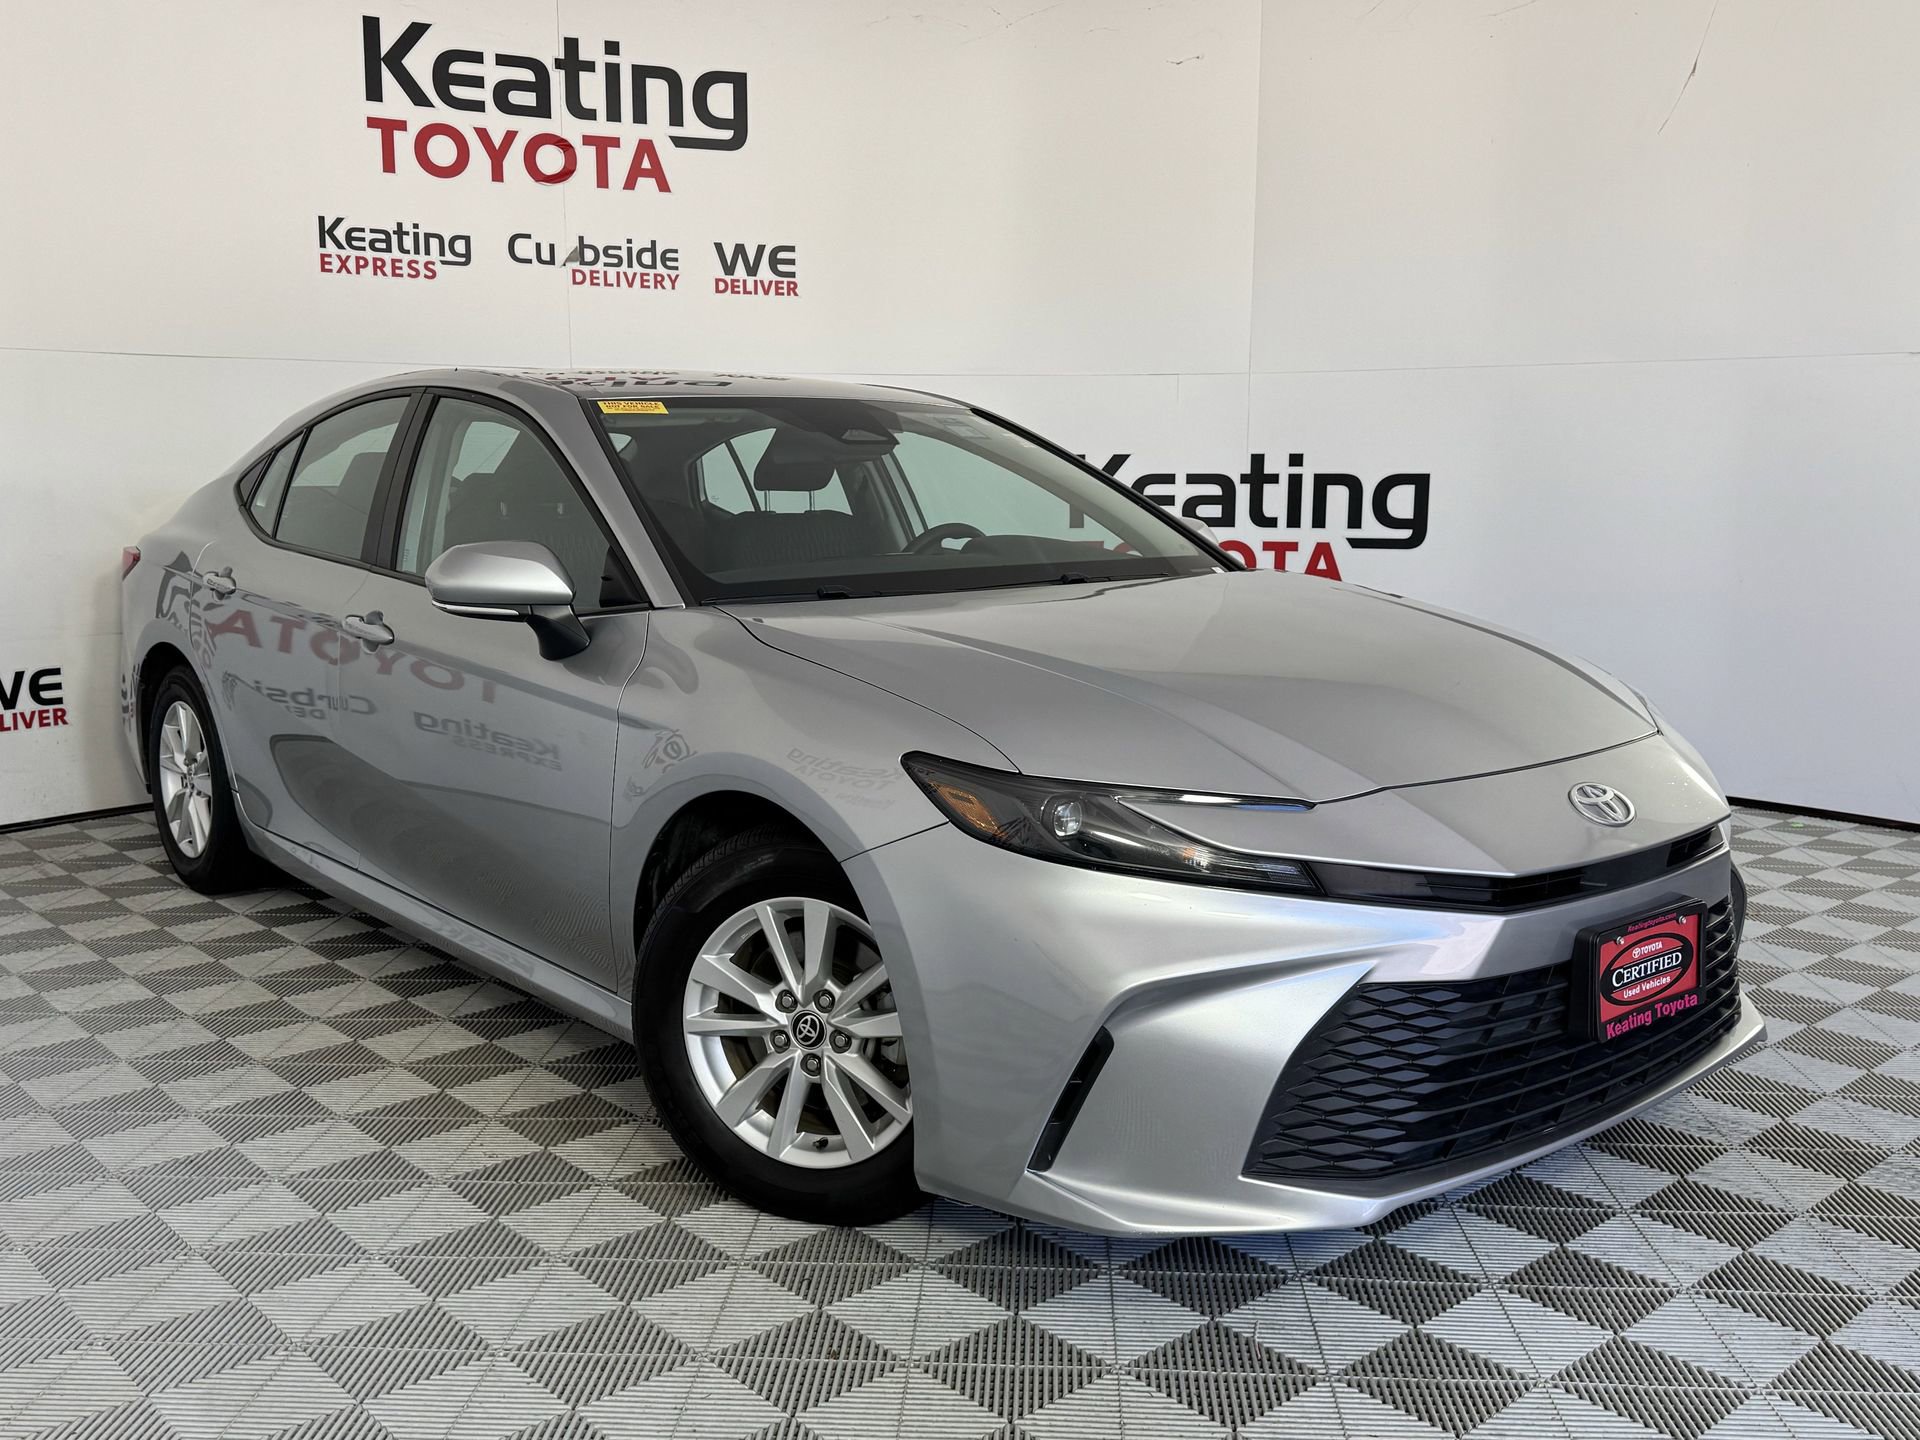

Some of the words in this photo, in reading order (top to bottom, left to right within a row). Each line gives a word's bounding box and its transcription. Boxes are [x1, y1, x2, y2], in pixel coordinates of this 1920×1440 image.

[362, 15, 748, 151] Keating
[366, 117, 672, 193] TOYOTA
[318, 216, 471, 267] Keating
[508, 233, 679, 271] Cubside
[319, 253, 437, 280] EXPRESS
[713, 242, 796, 278] WE
[571, 268, 680, 291] DELIVERY
[714, 278, 799, 297] DELIVER
[0, 707, 69, 732] LIVER
[1640, 941, 1663, 955] TOYOTA
[1612, 952, 1682, 987] CERTIFIED
[1623, 984, 1641, 999] Used
[1641, 975, 1671, 991] Vehicles
[1606, 1010, 1653, 1040] Keating
[1655, 993, 1698, 1018] Toyota
